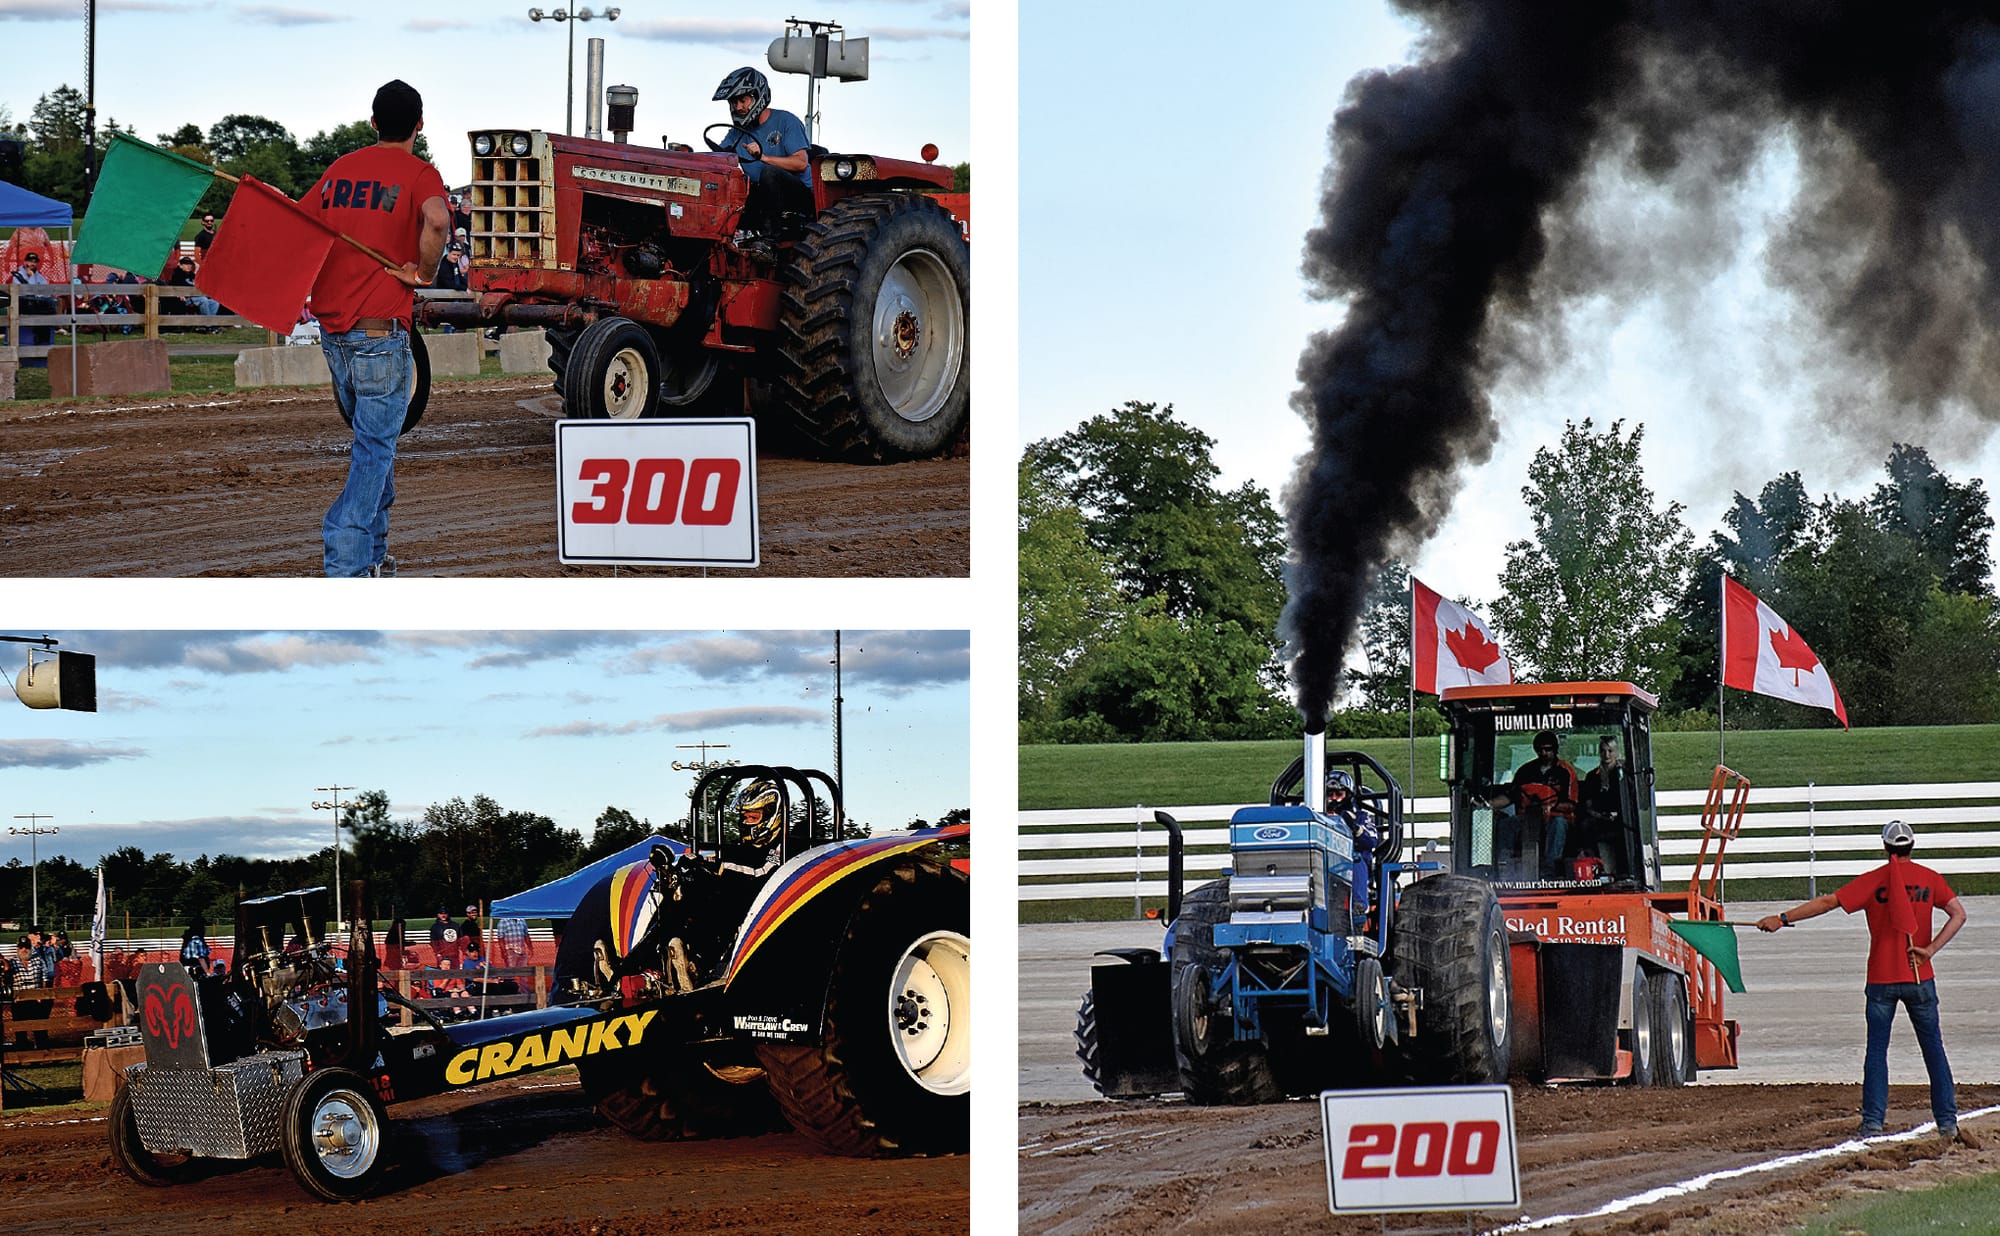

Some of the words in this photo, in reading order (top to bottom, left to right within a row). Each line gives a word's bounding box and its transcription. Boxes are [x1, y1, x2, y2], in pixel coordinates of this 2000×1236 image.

[321, 178, 400, 213] CREW
[572, 458, 741, 526] 300
[1494, 713, 1574, 731] HUMILIATOR
[1875, 884, 1931, 903] CEW
[1505, 917, 1549, 936] Sled
[1558, 915, 1626, 936] Rental
[734, 1016, 778, 1031] WHITELAW
[782, 1018, 808, 1032] CREW
[445, 1009, 659, 1085] CRANKY
[1342, 1120, 1501, 1180] 200
